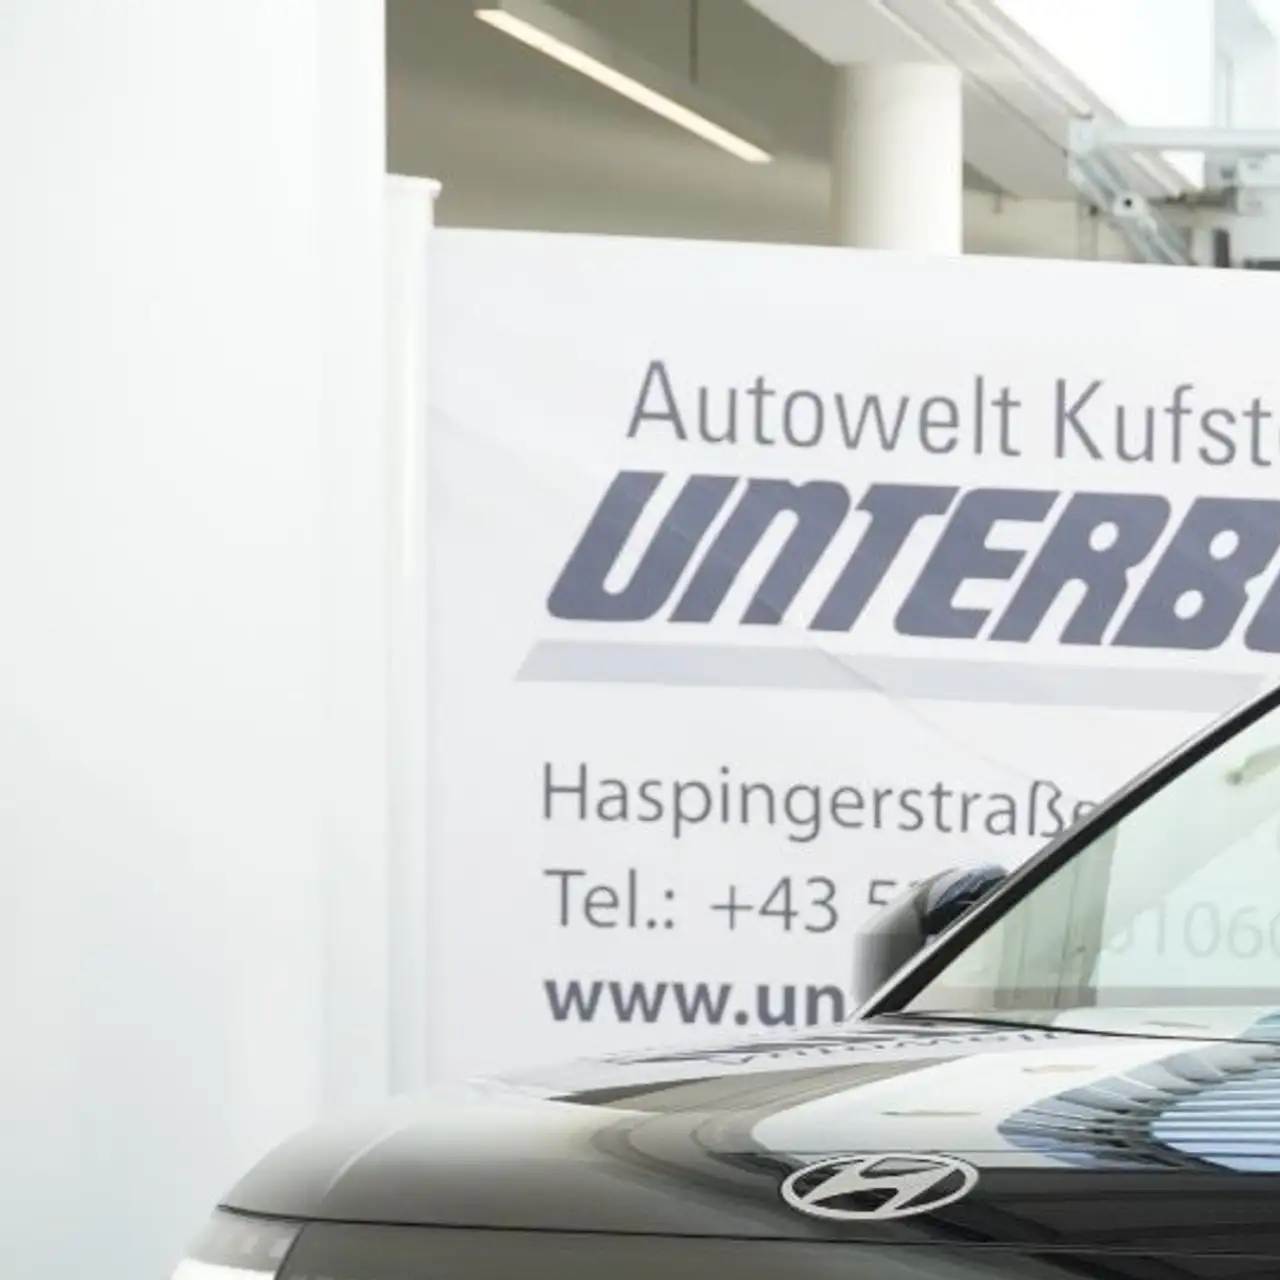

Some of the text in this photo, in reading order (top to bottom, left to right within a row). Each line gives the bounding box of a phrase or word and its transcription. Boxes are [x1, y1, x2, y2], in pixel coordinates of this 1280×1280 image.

[625, 359, 1022, 458] Autowelt
[542, 867, 676, 930] Tel.:
[710, 875, 840, 933] +43
[543, 979, 846, 1026] www.un
